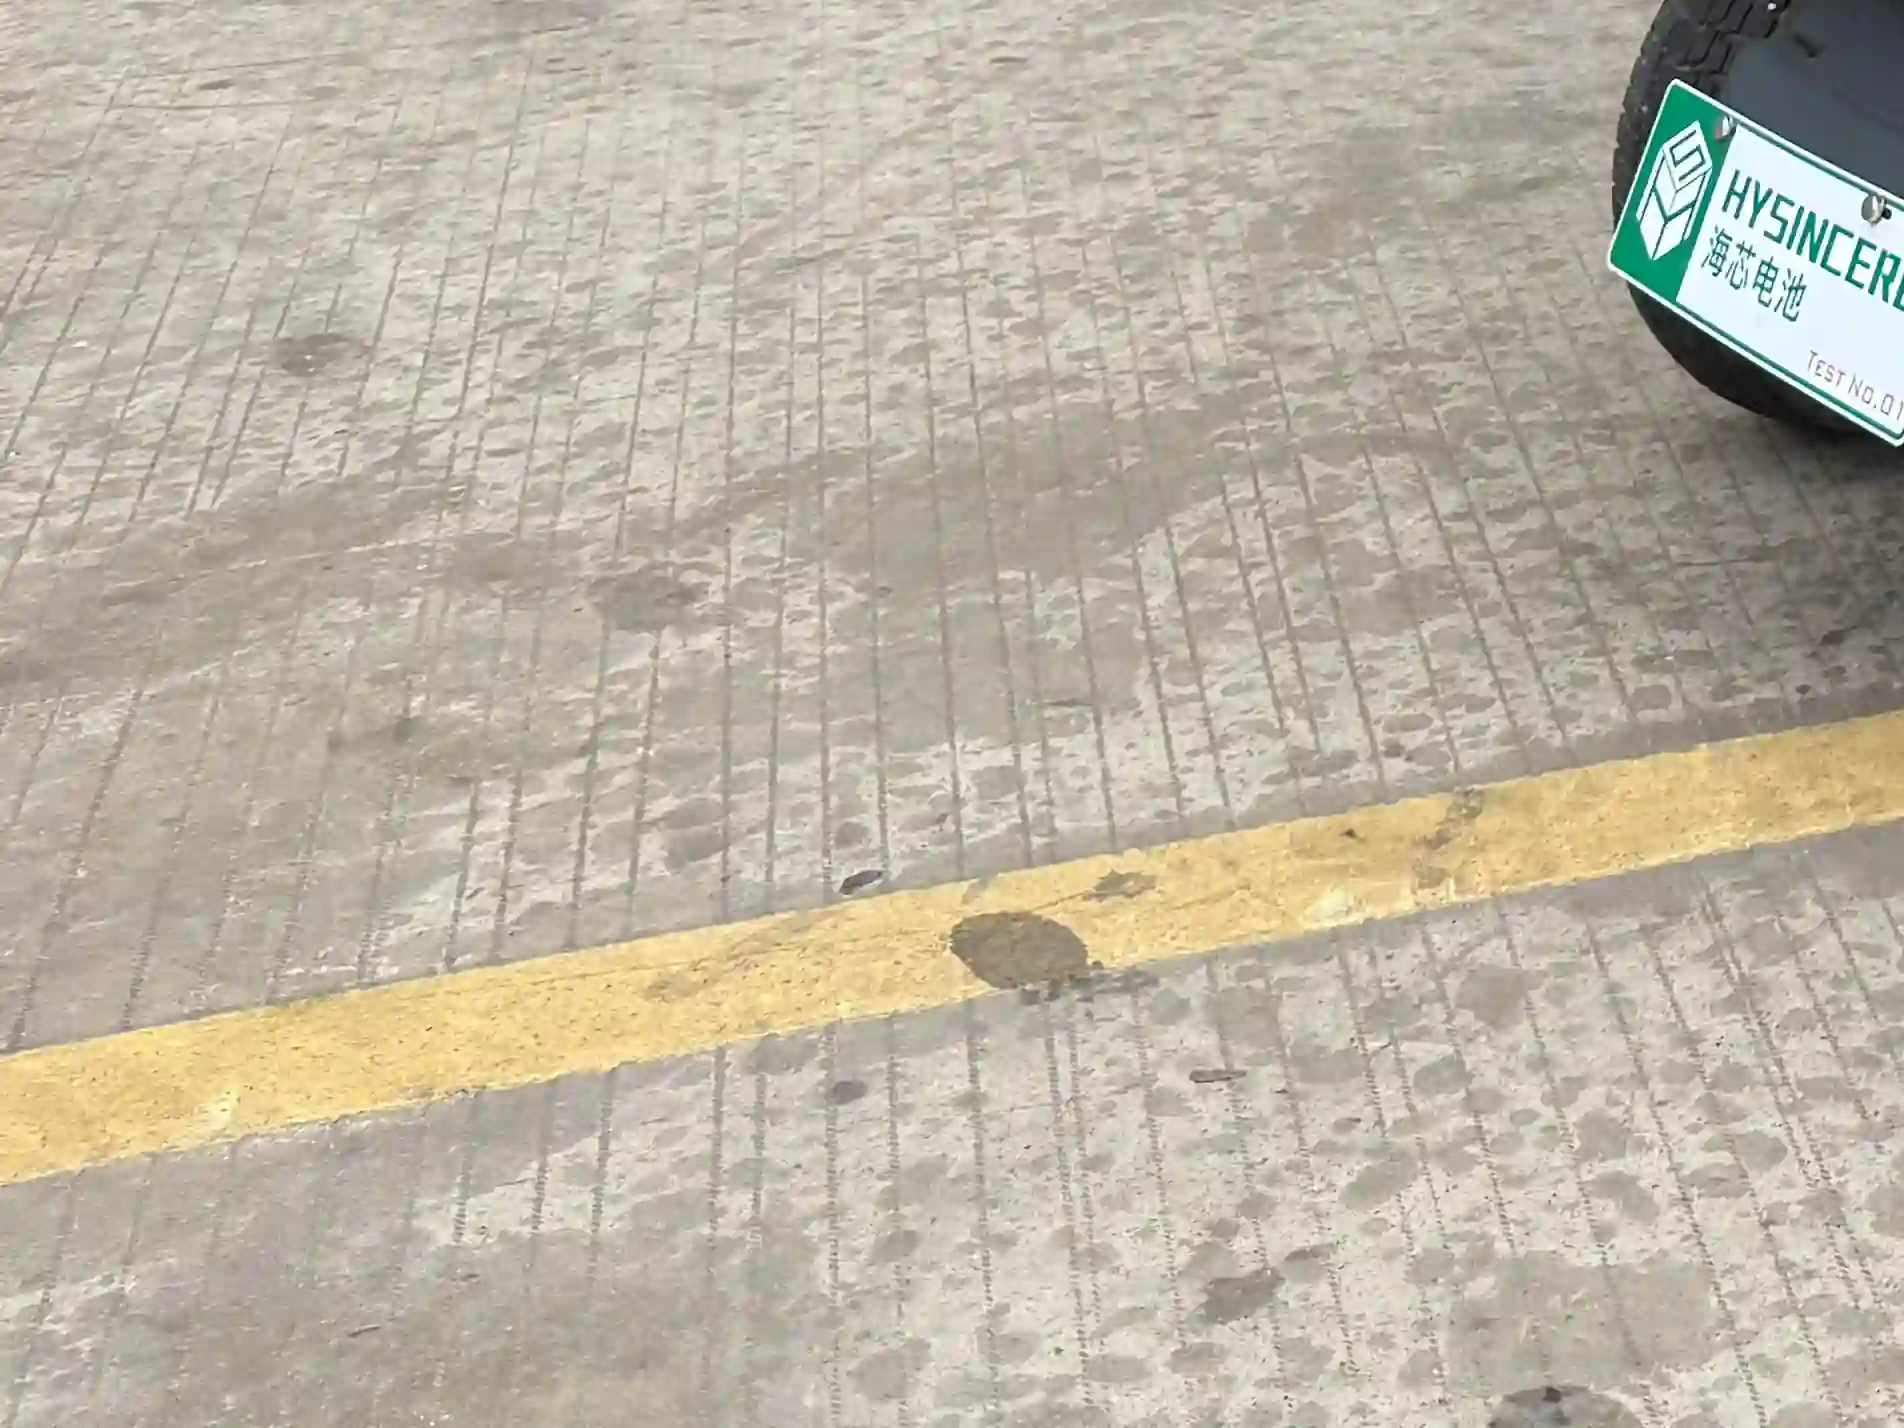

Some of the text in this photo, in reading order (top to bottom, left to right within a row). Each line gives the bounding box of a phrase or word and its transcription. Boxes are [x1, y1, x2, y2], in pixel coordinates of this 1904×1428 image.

[1701, 224, 1808, 322] 海芯电池
[1807, 349, 1847, 387] TEST
